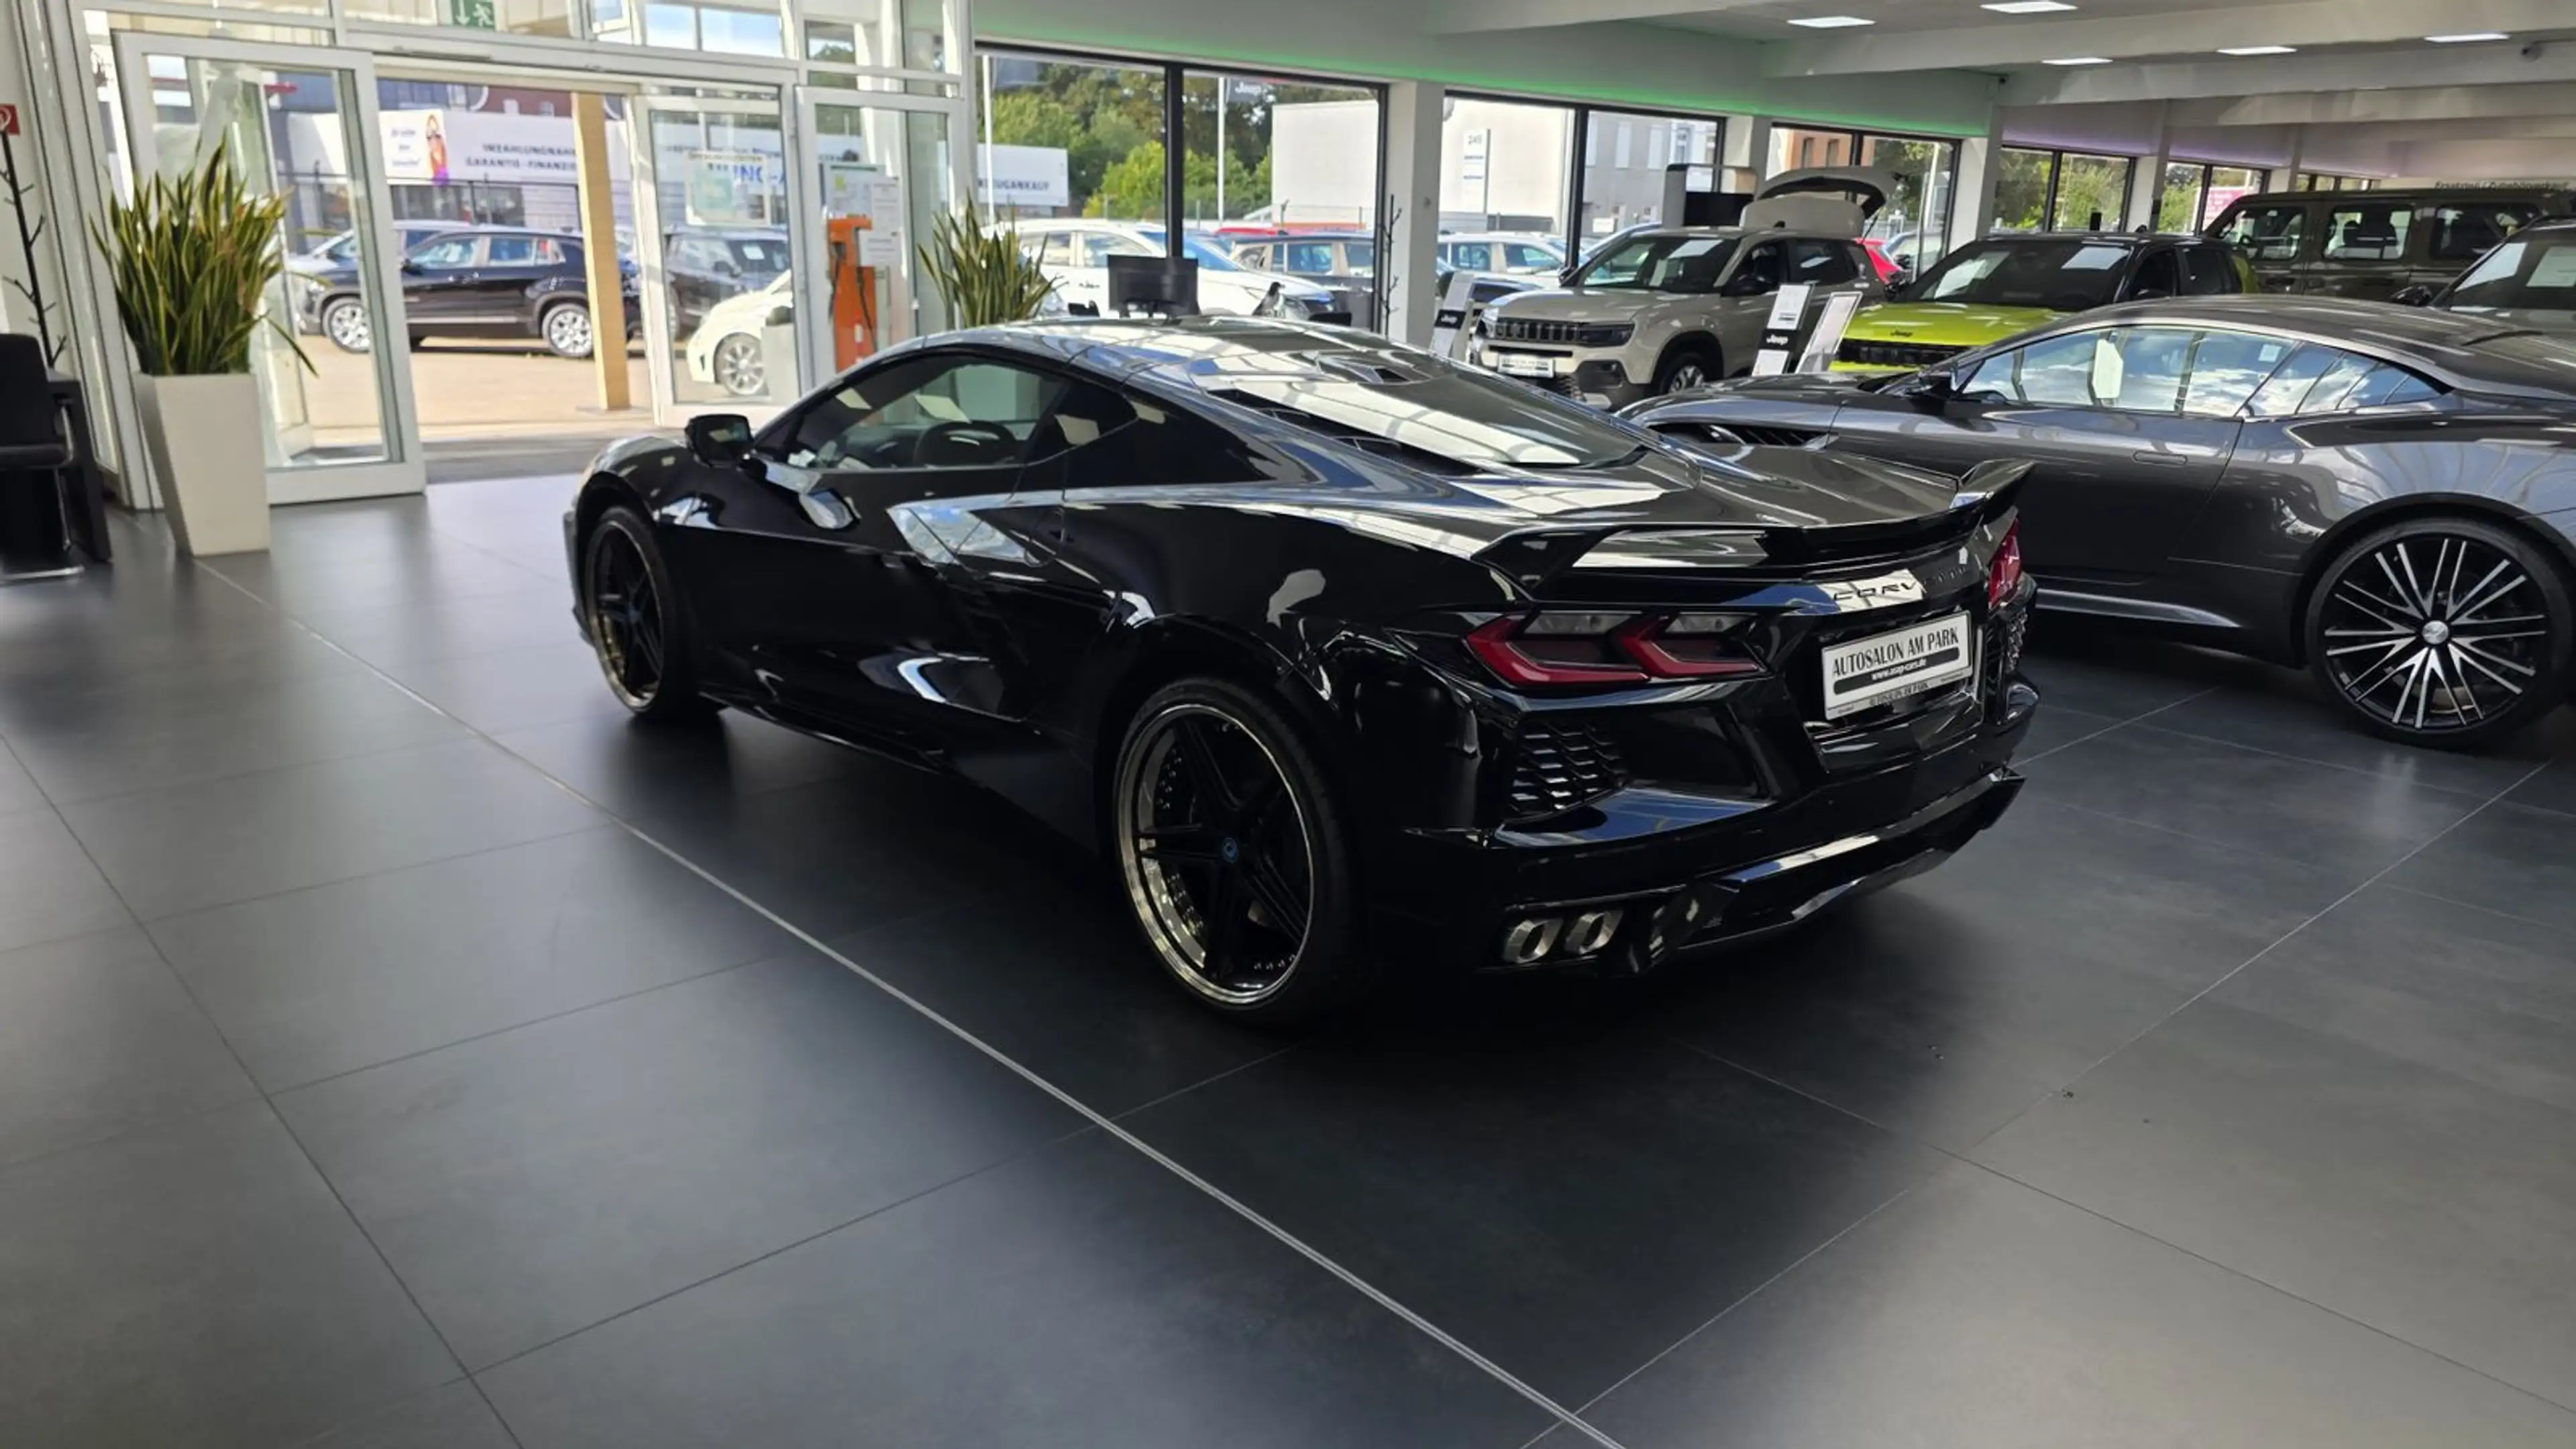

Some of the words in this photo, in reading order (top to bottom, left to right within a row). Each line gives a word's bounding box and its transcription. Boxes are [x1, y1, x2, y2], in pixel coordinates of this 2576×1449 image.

[1766, 334, 1789, 345] Jeep
[1832, 641, 1904, 678] AUTOSALON
[1907, 637, 1925, 656] AM
[1927, 627, 1959, 651] PARK
